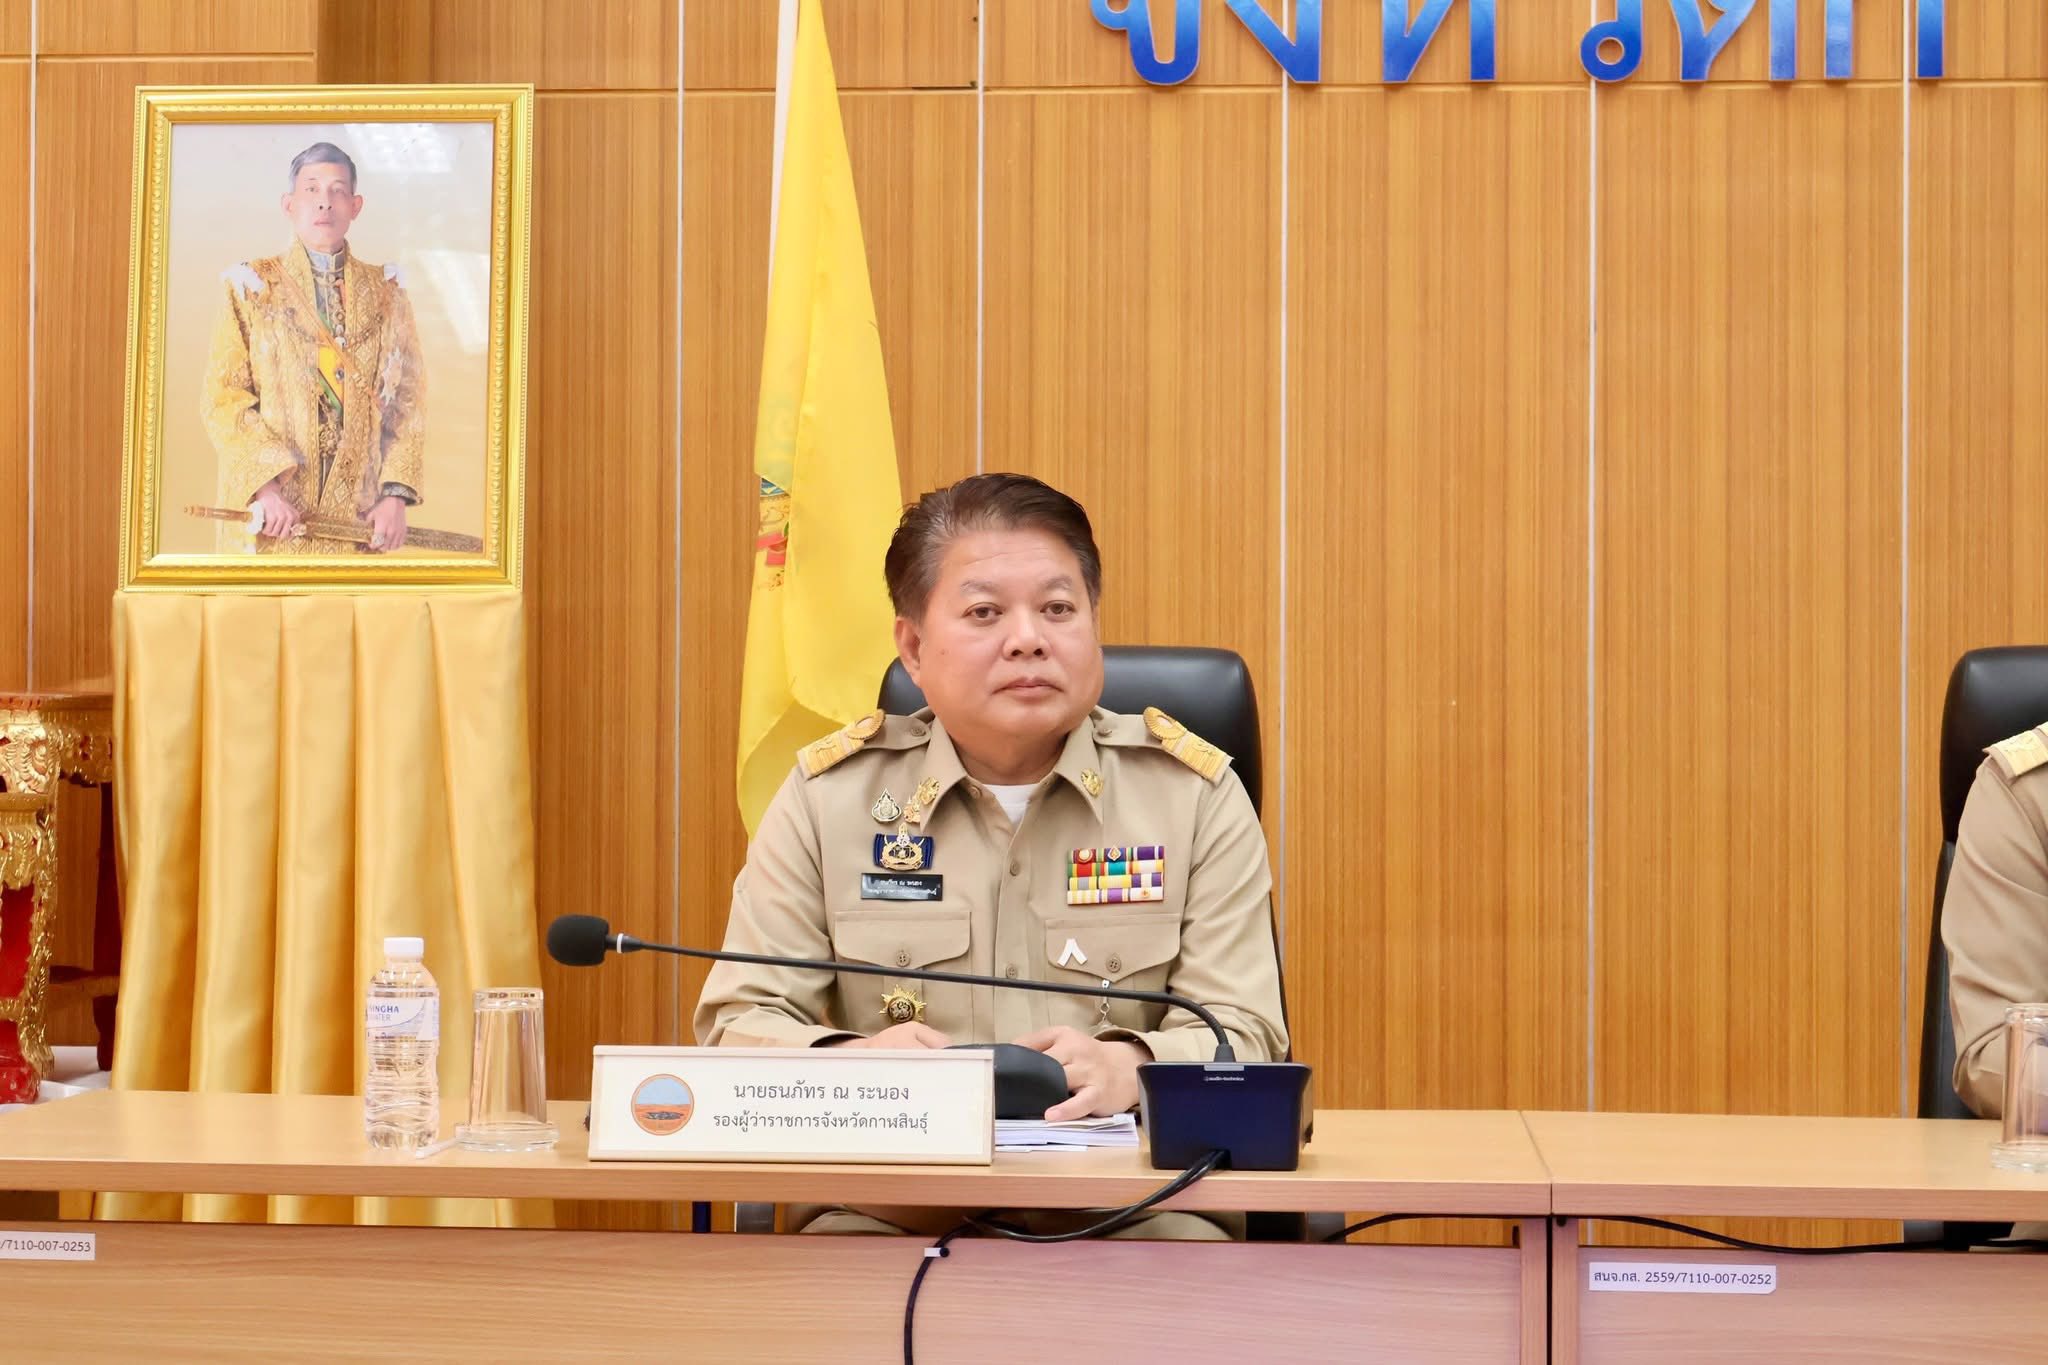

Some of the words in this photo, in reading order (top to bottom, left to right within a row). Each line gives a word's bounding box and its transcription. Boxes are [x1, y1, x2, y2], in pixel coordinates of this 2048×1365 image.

[733, 1079, 826, 1100] นายธนภัทร
[833, 1086, 849, 1100] ณ
[856, 1086, 909, 1101] ระนอง
[712, 1109, 929, 1135] รองผู้ว่าราชการจังหวัดกาฬสินธุ์
[1593, 1271, 1641, 1284] สนจ.กส.
[1644, 1271, 1772, 1286] 2559/7110-007-0252
